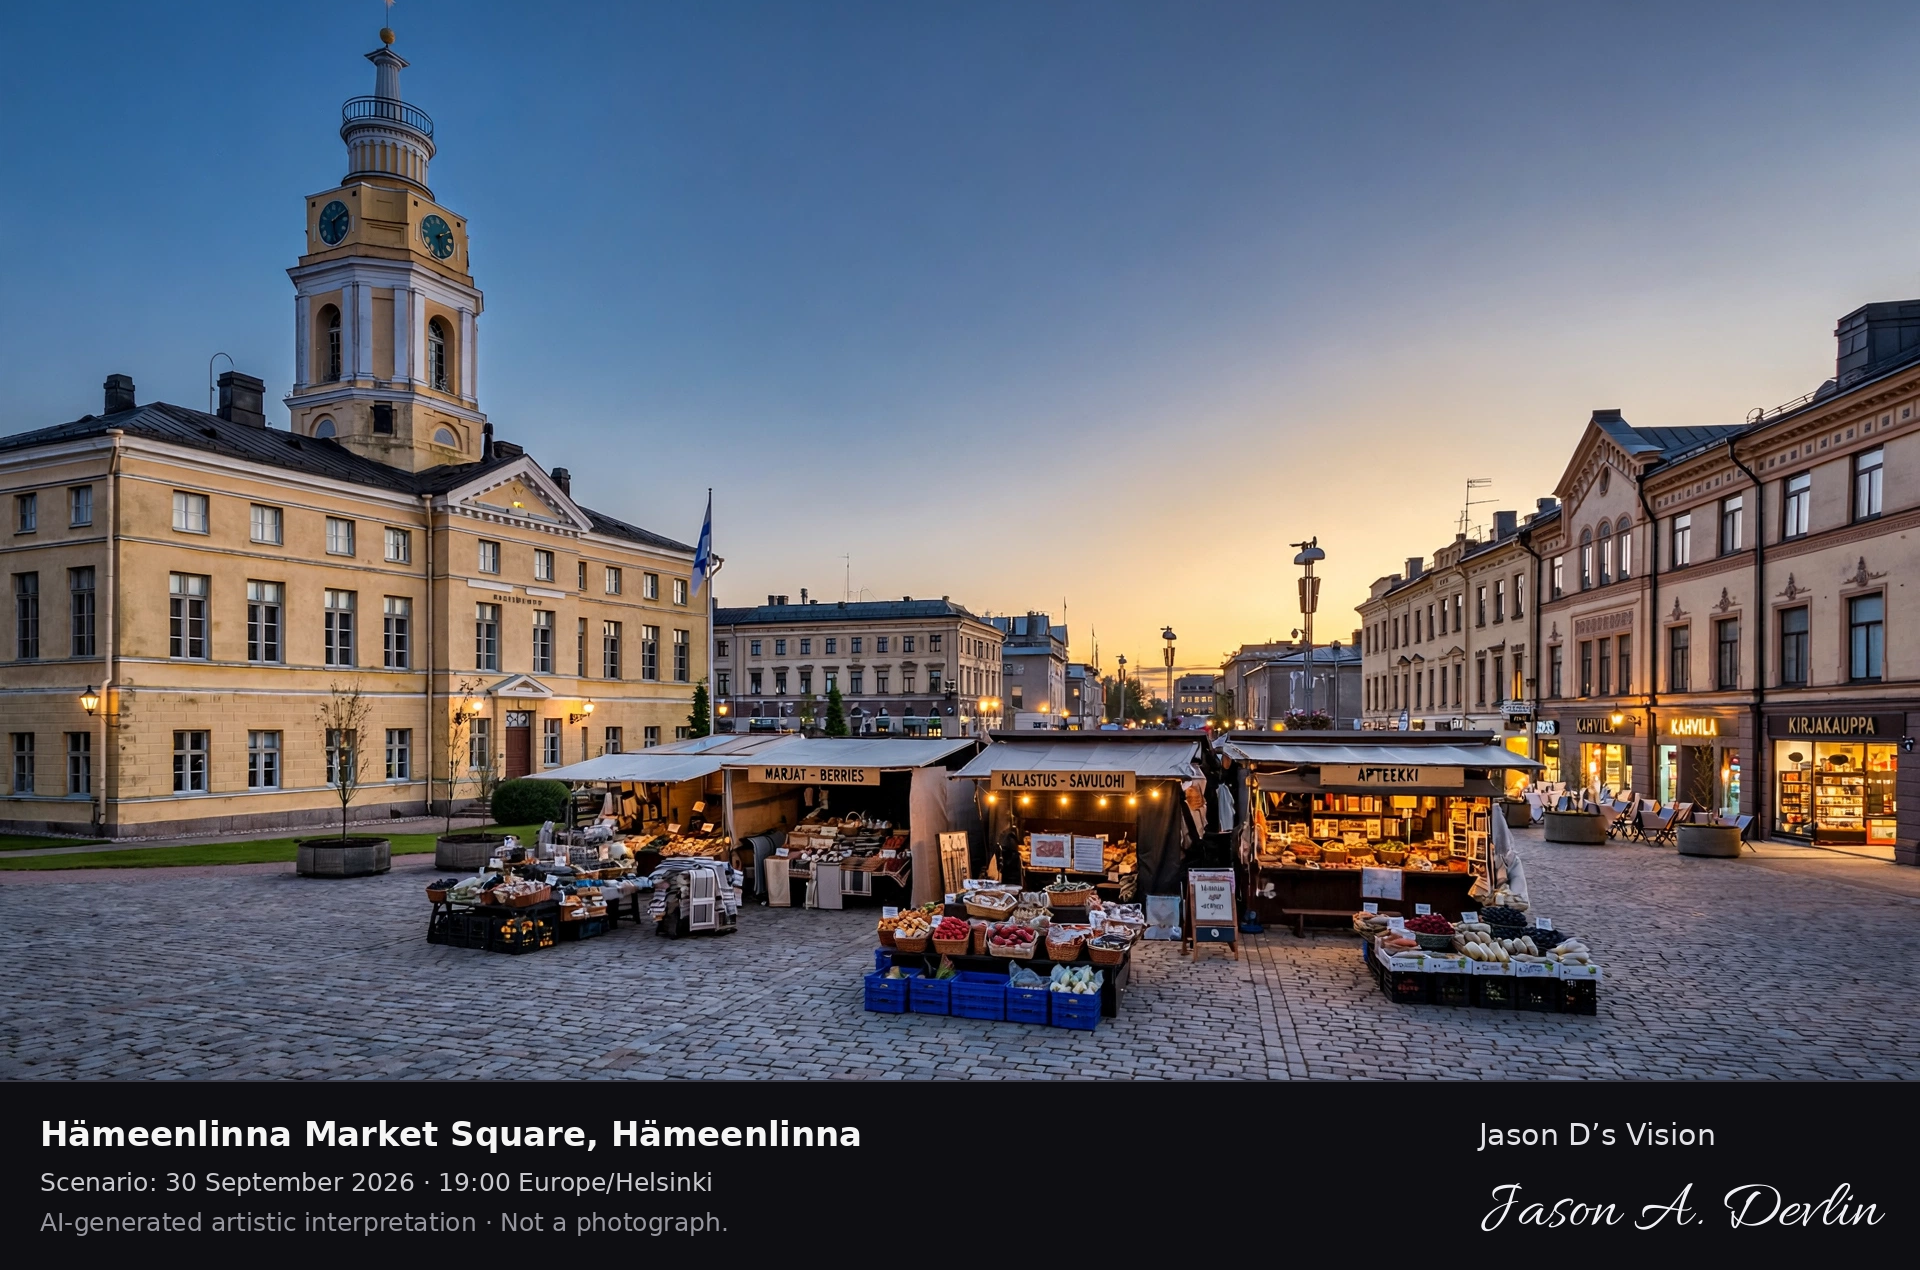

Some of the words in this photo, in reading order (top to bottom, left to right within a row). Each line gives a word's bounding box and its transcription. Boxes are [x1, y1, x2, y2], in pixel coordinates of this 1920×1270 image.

[1671, 718, 1717, 736] KAHVILA
[1788, 716, 1875, 735] KIRJAKAUPPA
[765, 767, 806, 781] MARJAT
[820, 768, 865, 782] BERRIES
[1001, 773, 1057, 787] KALASTUS
[1069, 774, 1125, 788] SAVULOHI
[1357, 767, 1419, 782] APTEEKKI
